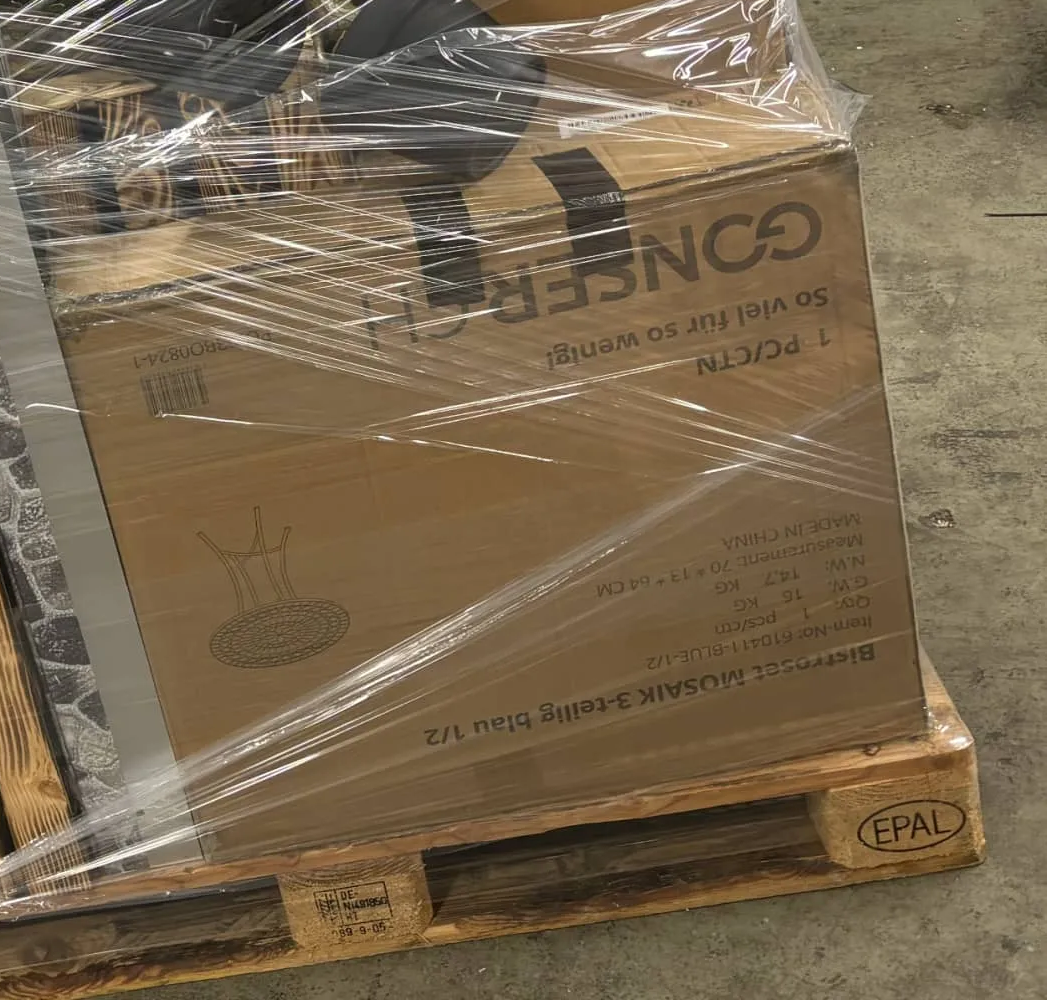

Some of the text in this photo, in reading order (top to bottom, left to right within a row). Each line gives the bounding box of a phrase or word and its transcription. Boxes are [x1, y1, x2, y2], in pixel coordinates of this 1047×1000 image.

[546, 287, 829, 371] So viel für so wenig!
[697, 328, 831, 375] 1 PC/CTN
[722, 511, 861, 550] MADE IN CHINA
[670, 568, 690, 582] 13
[710, 560, 732, 574] 70
[596, 581, 625, 597] CM
[715, 579, 739, 594] KG
[734, 596, 758, 612] KG
[802, 607, 809, 619] 1
[714, 610, 776, 634] pcs/ctn
[424, 643, 875, 746] Bistroset MOSAIK 3-teilig blau 1/2
[873, 809, 952, 845] EPAL
